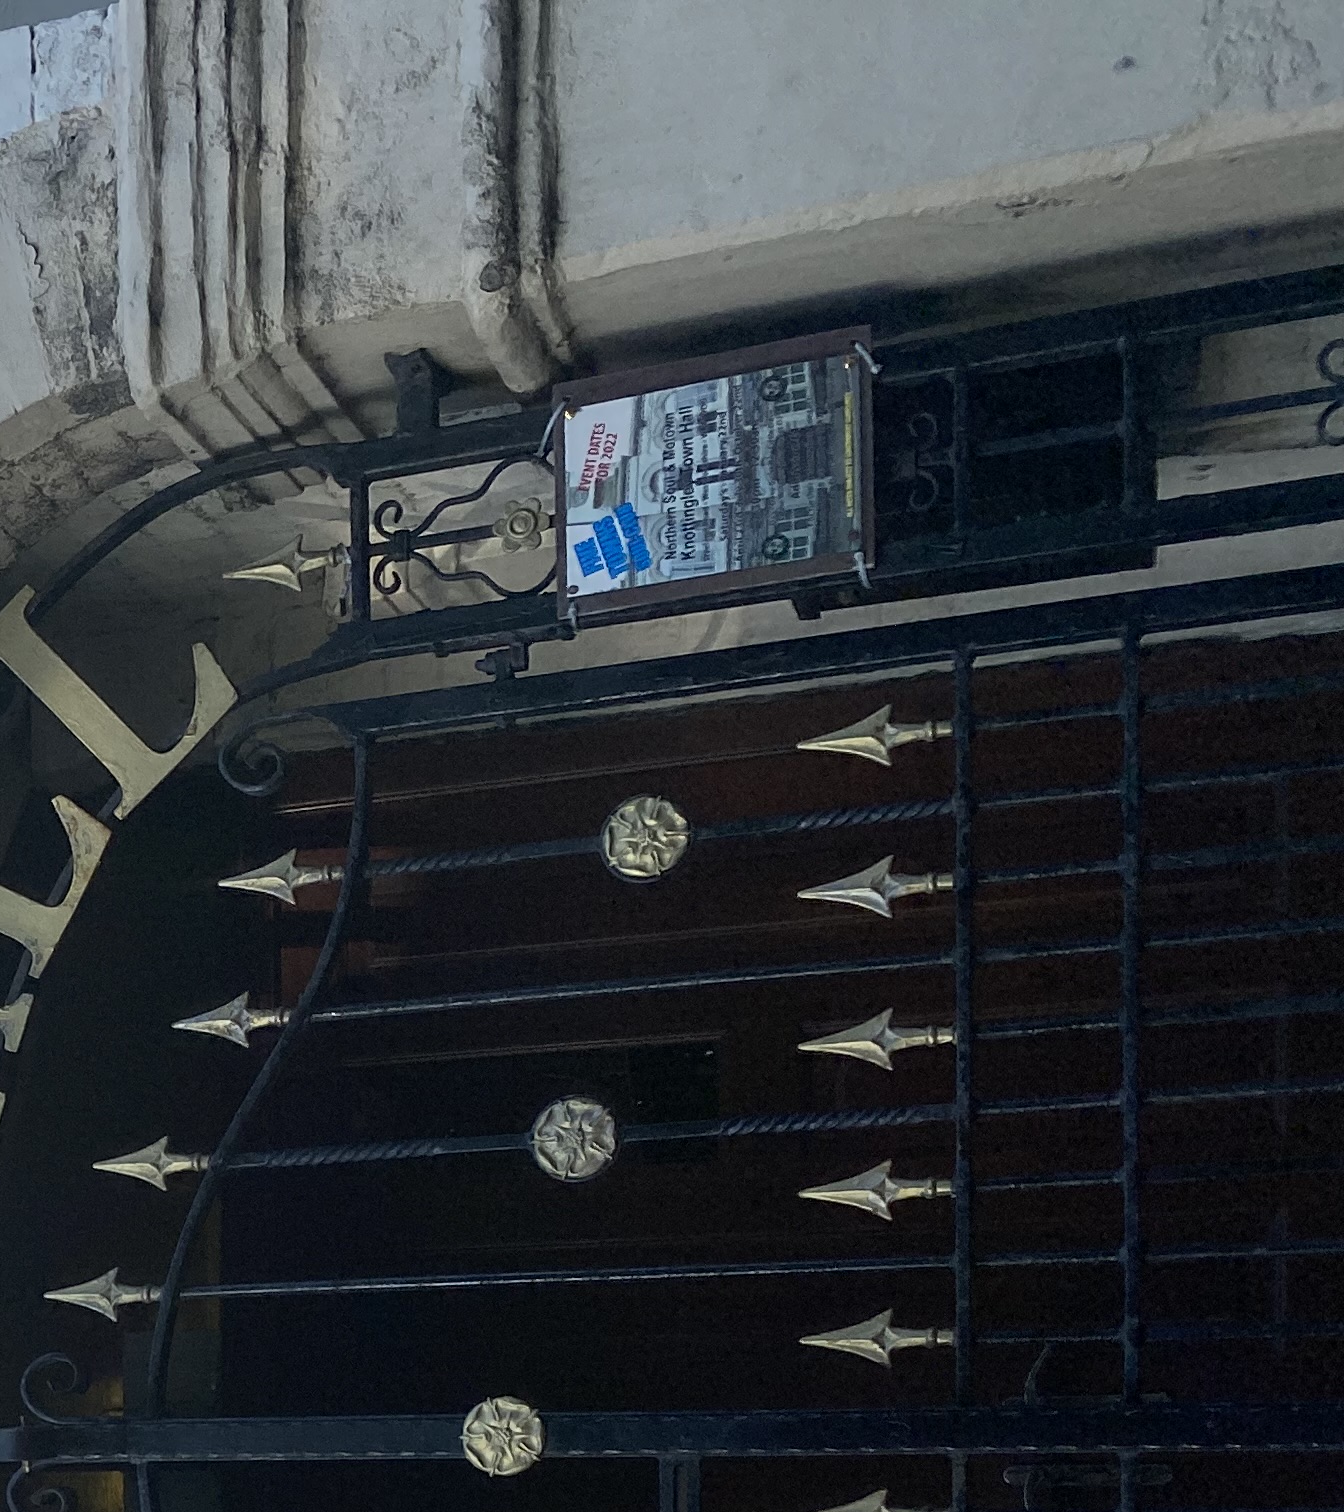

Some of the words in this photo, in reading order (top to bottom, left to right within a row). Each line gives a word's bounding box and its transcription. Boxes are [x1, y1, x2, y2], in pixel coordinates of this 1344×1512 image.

[678, 405, 693, 434] Hall
[600, 432, 618, 460] 2022
[662, 411, 676, 461] Motown
[576, 458, 597, 493] EVENT
[587, 422, 606, 455] DATES
[661, 463, 676, 473] &
[595, 462, 612, 483] FOR
[661, 476, 676, 504] Soul
[663, 506, 678, 560] Northern
